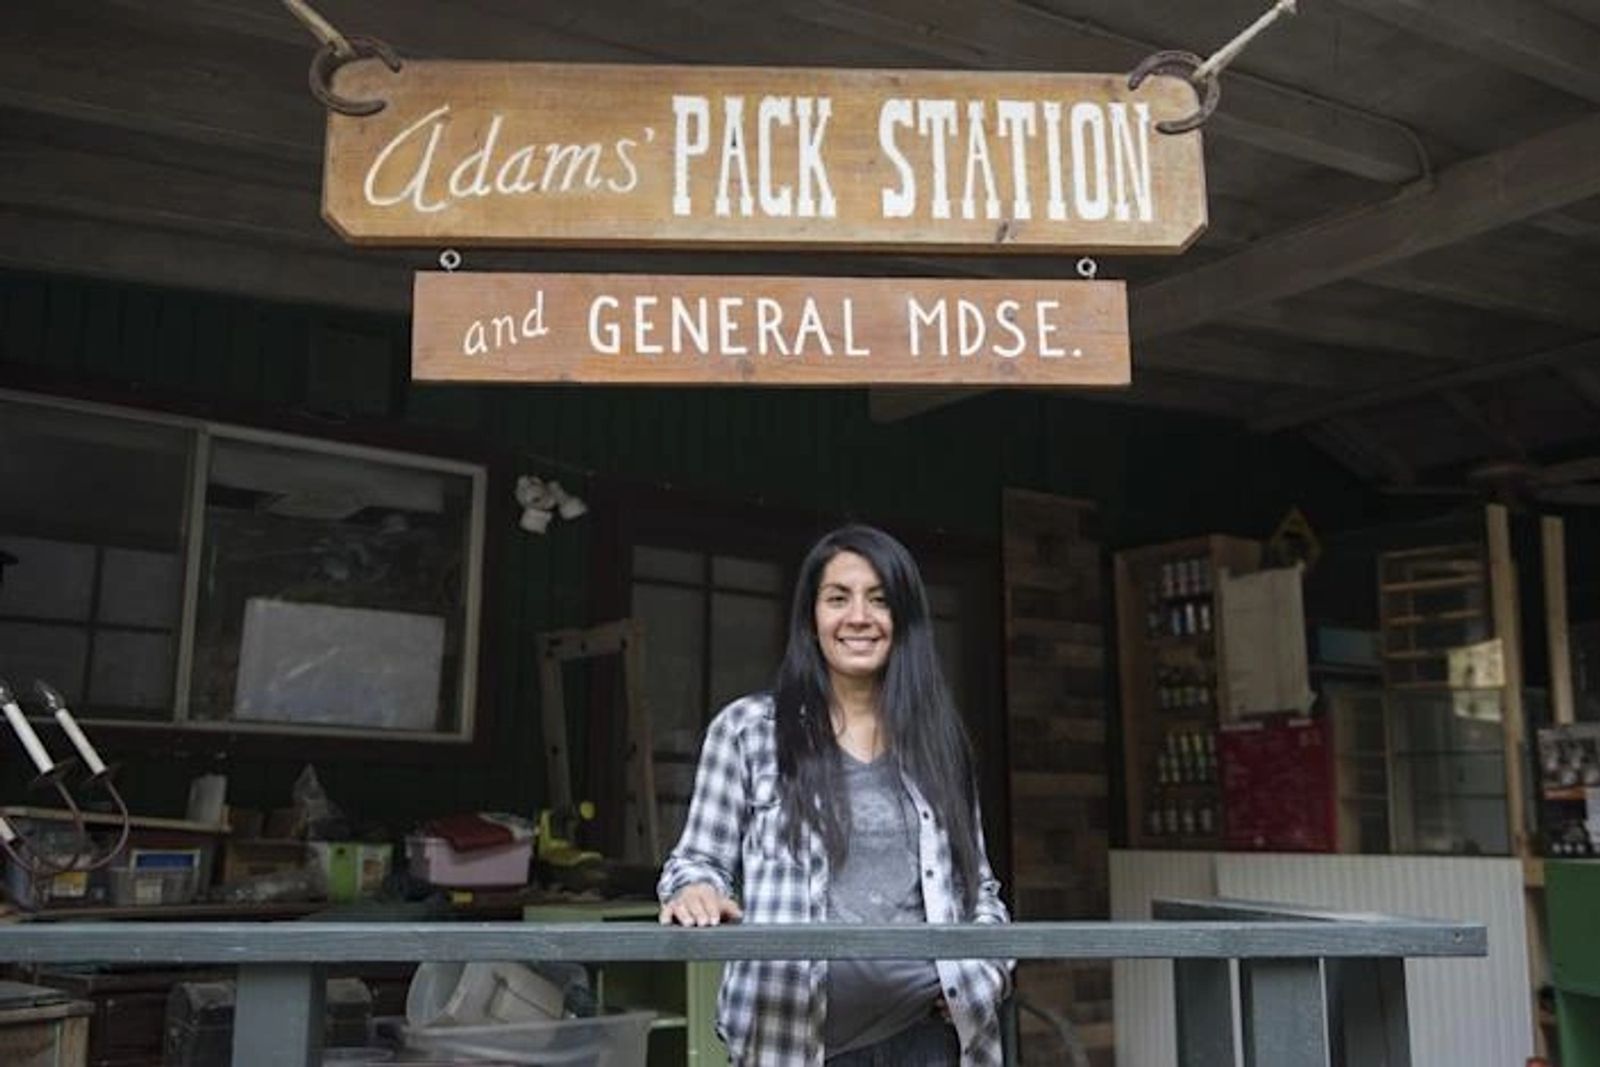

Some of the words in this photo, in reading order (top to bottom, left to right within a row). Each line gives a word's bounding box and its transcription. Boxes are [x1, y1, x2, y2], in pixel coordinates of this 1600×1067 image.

[364, 104, 655, 213] Adams'
[672, 95, 837, 219] PACK
[878, 98, 1154, 222] STATION
[463, 290, 549, 356] and
[588, 295, 870, 357] GENERAL
[908, 298, 1082, 358] MDSE.
